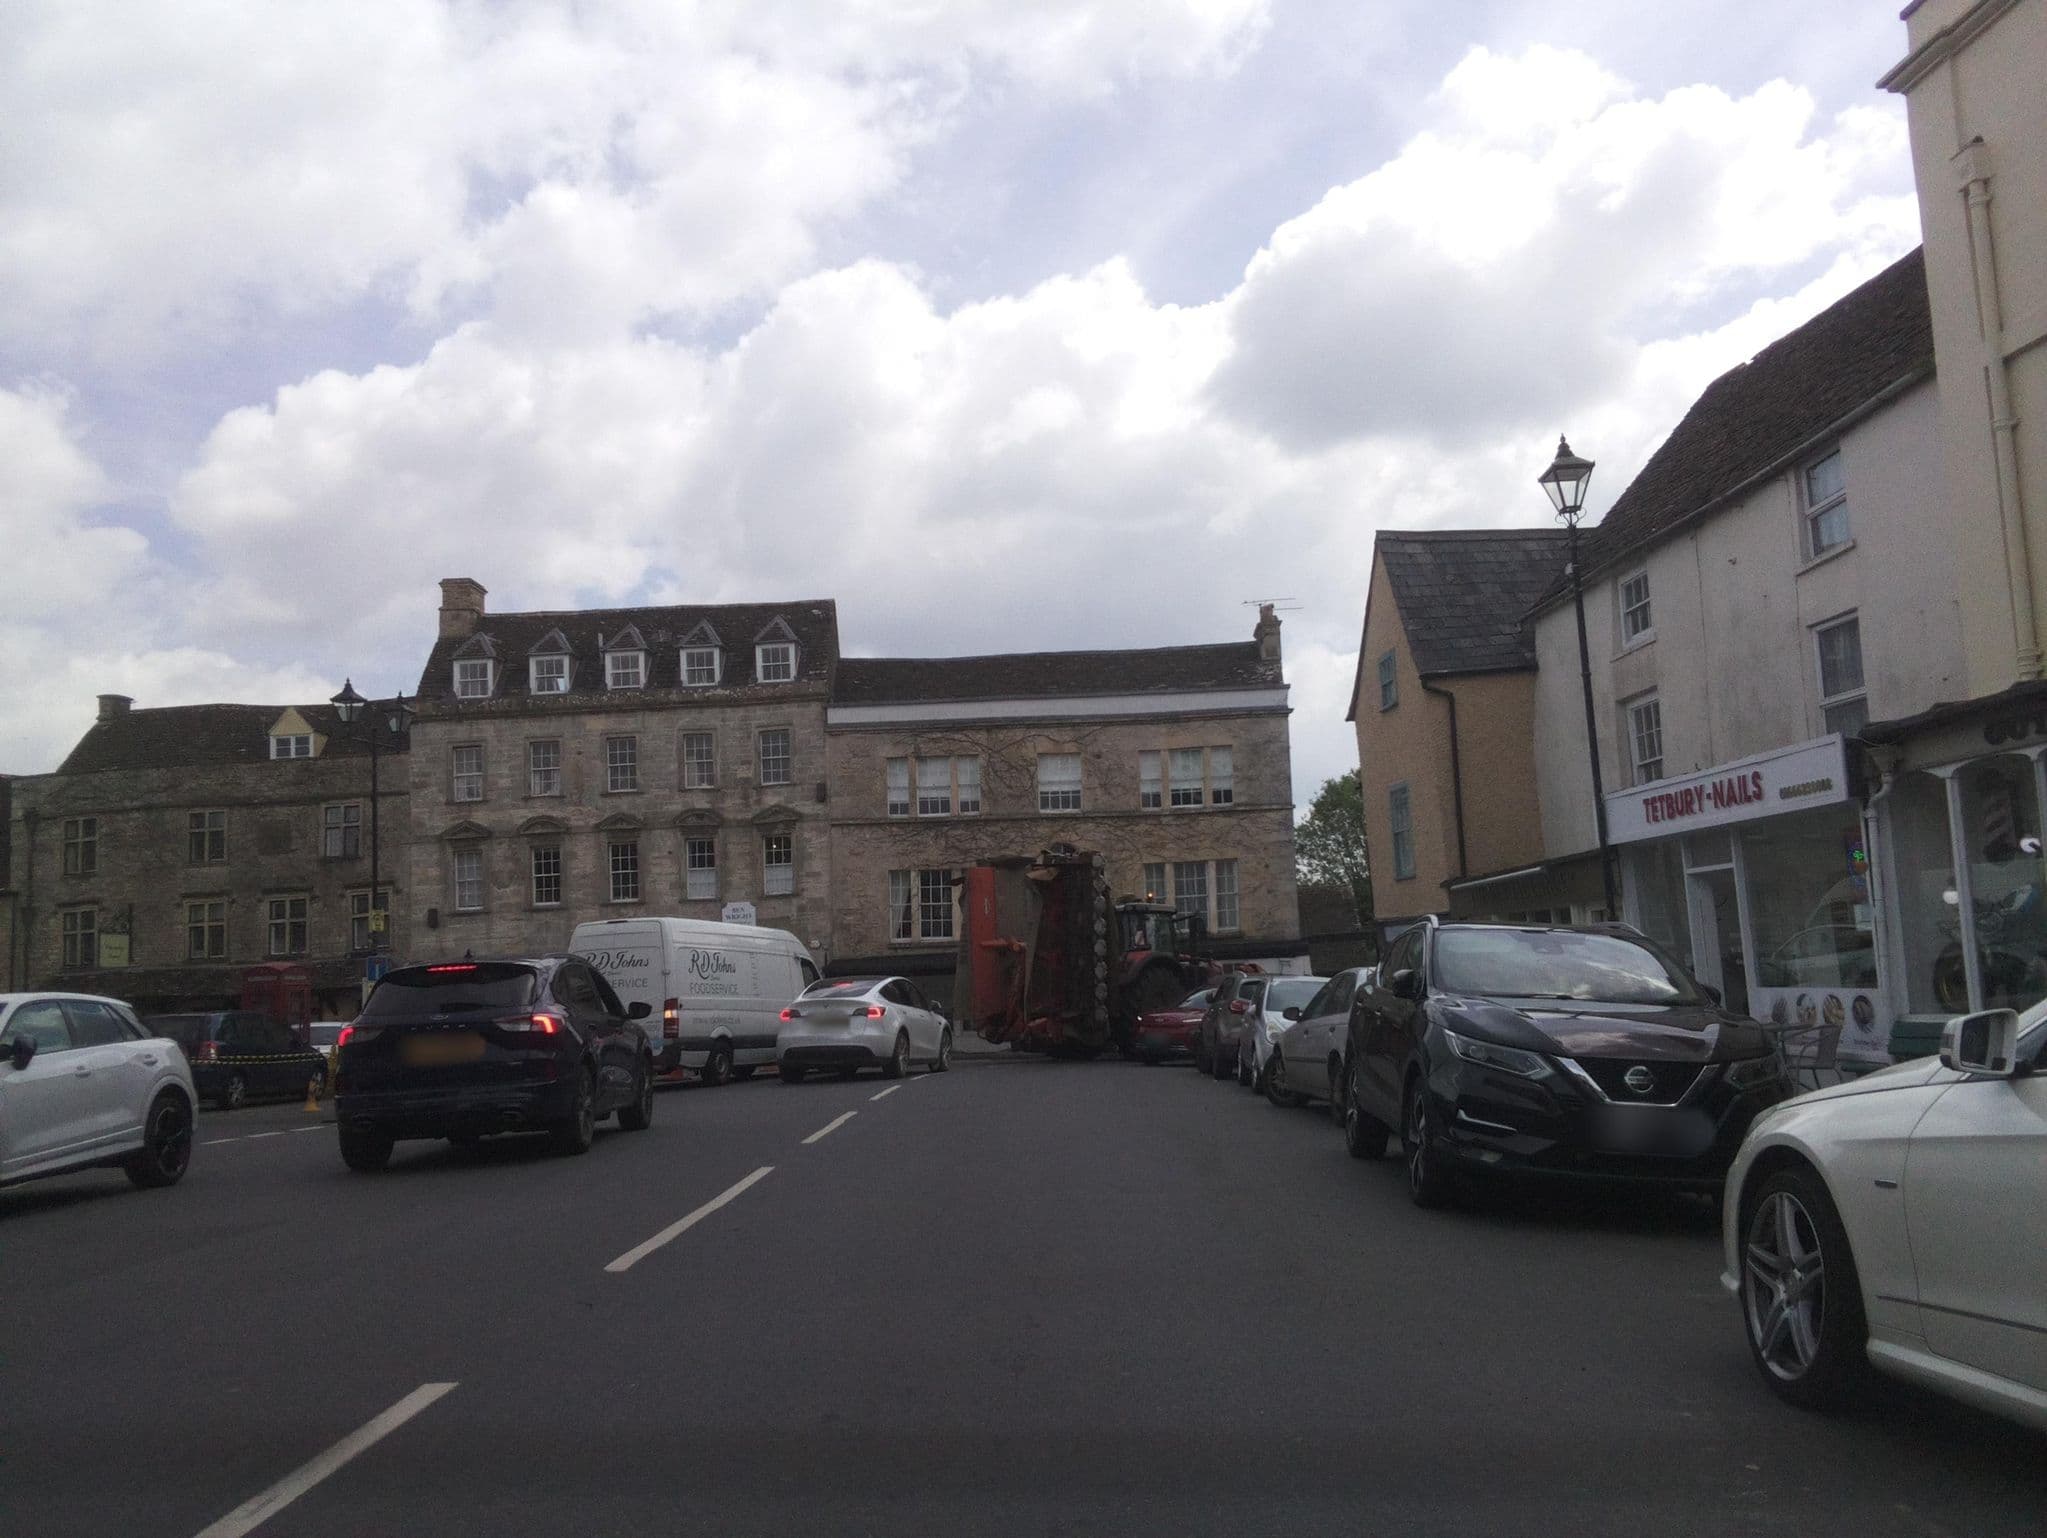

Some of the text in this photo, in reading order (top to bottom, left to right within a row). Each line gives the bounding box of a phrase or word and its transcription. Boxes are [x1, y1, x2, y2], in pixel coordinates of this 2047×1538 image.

[610, 951, 649, 970] Johns
[711, 951, 737, 974] Johns
[689, 982, 738, 995] FOODSERVICE
